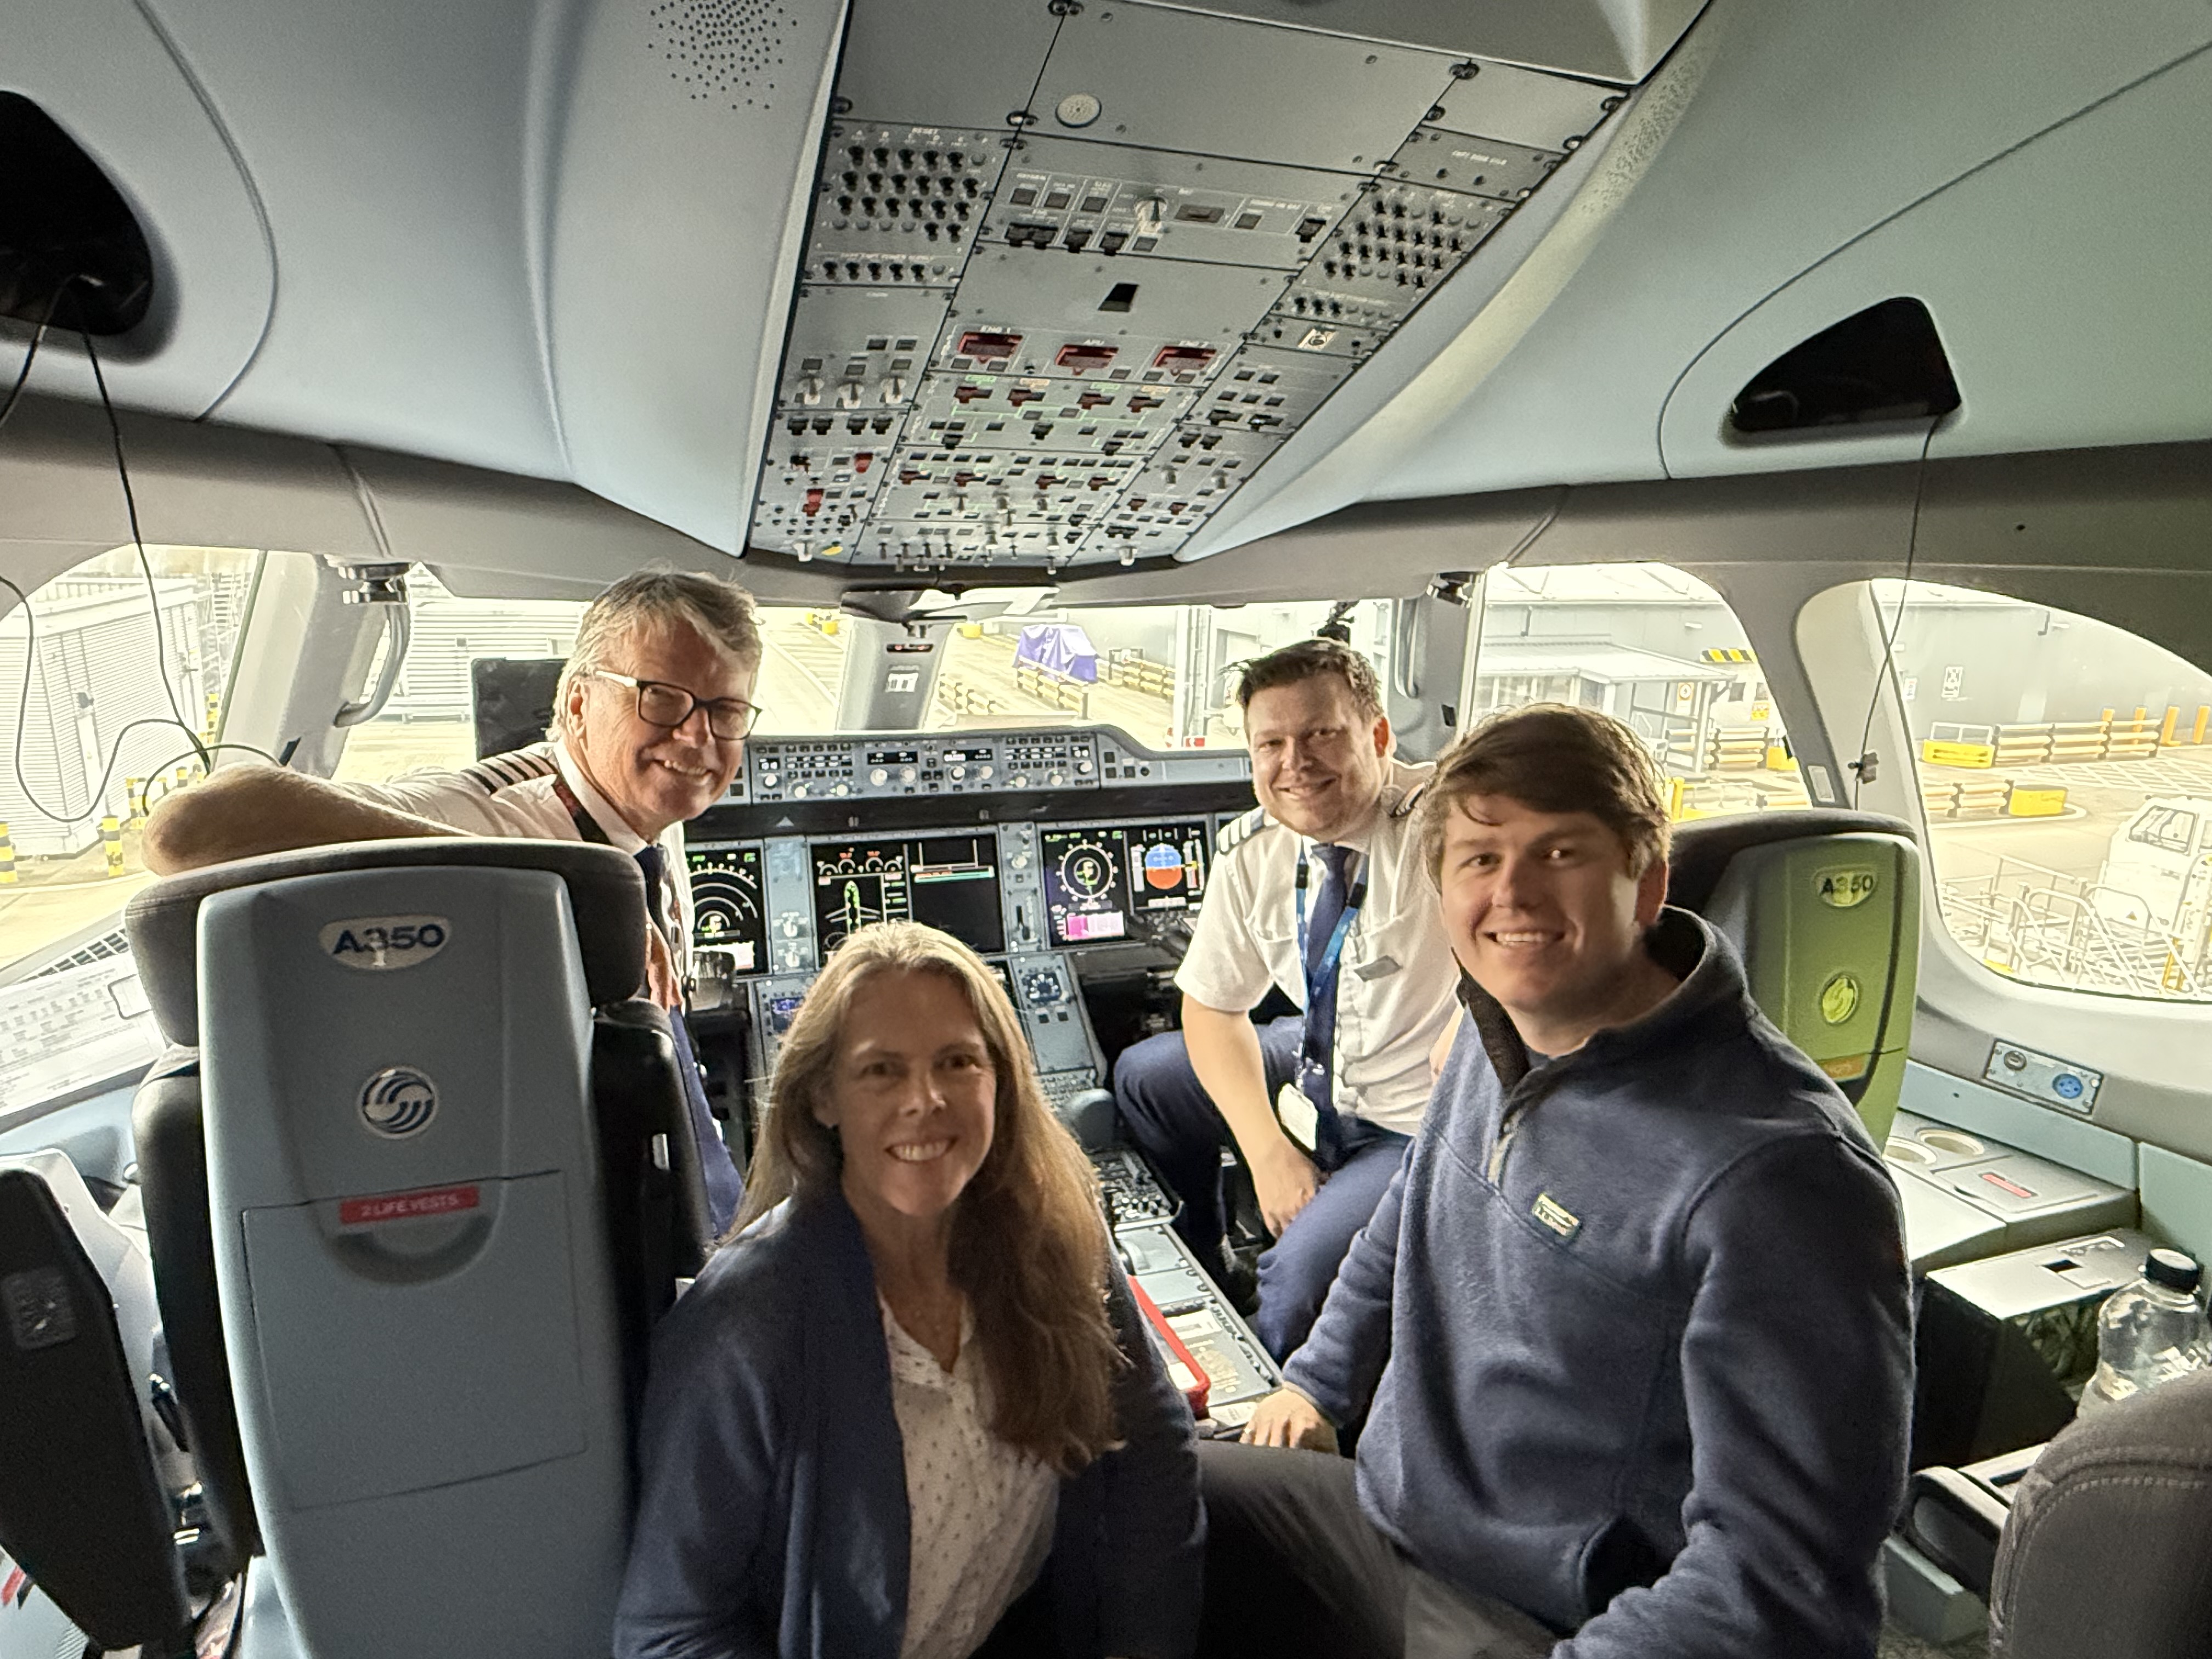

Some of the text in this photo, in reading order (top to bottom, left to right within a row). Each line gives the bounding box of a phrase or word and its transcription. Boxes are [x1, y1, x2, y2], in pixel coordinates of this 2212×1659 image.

[1819, 874, 1874, 896] A350
[333, 923, 445, 955] A350
[360, 1193, 459, 1217] 2 LIFE VESTS
